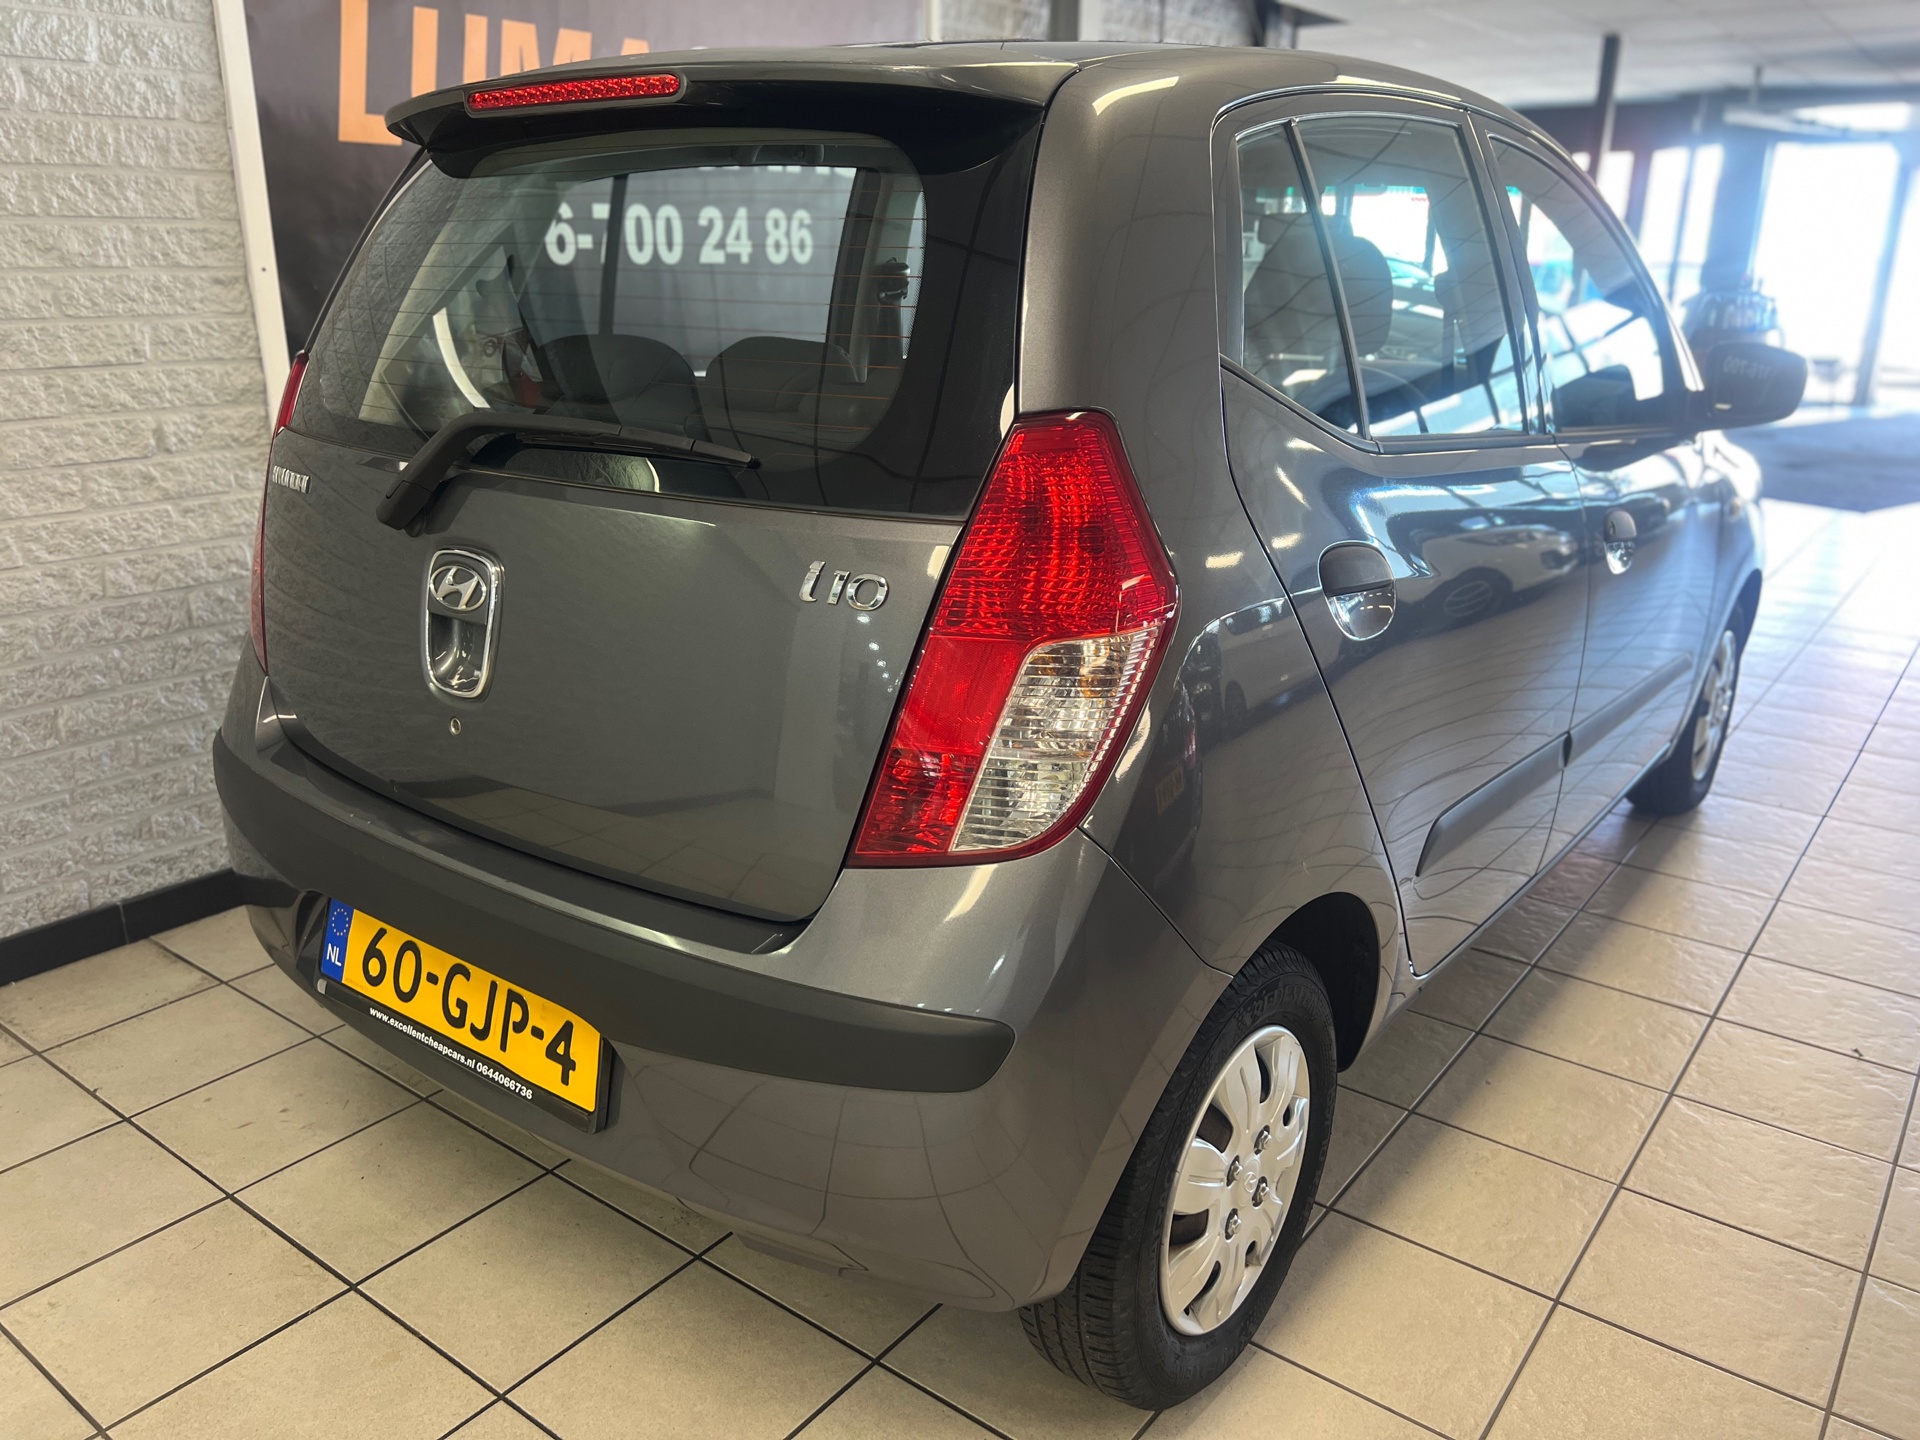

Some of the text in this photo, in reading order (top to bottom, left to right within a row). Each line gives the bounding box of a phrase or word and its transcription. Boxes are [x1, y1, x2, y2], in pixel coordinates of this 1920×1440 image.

[338, 0, 651, 146] LU
[698, 206, 752, 265] 24
[765, 208, 813, 265] 86
[326, 943, 342, 967] NL
[362, 927, 577, 1086] 60-GJP-4
[369, 1006, 533, 1100] www.excellentcheapcars.nl 0644066736
